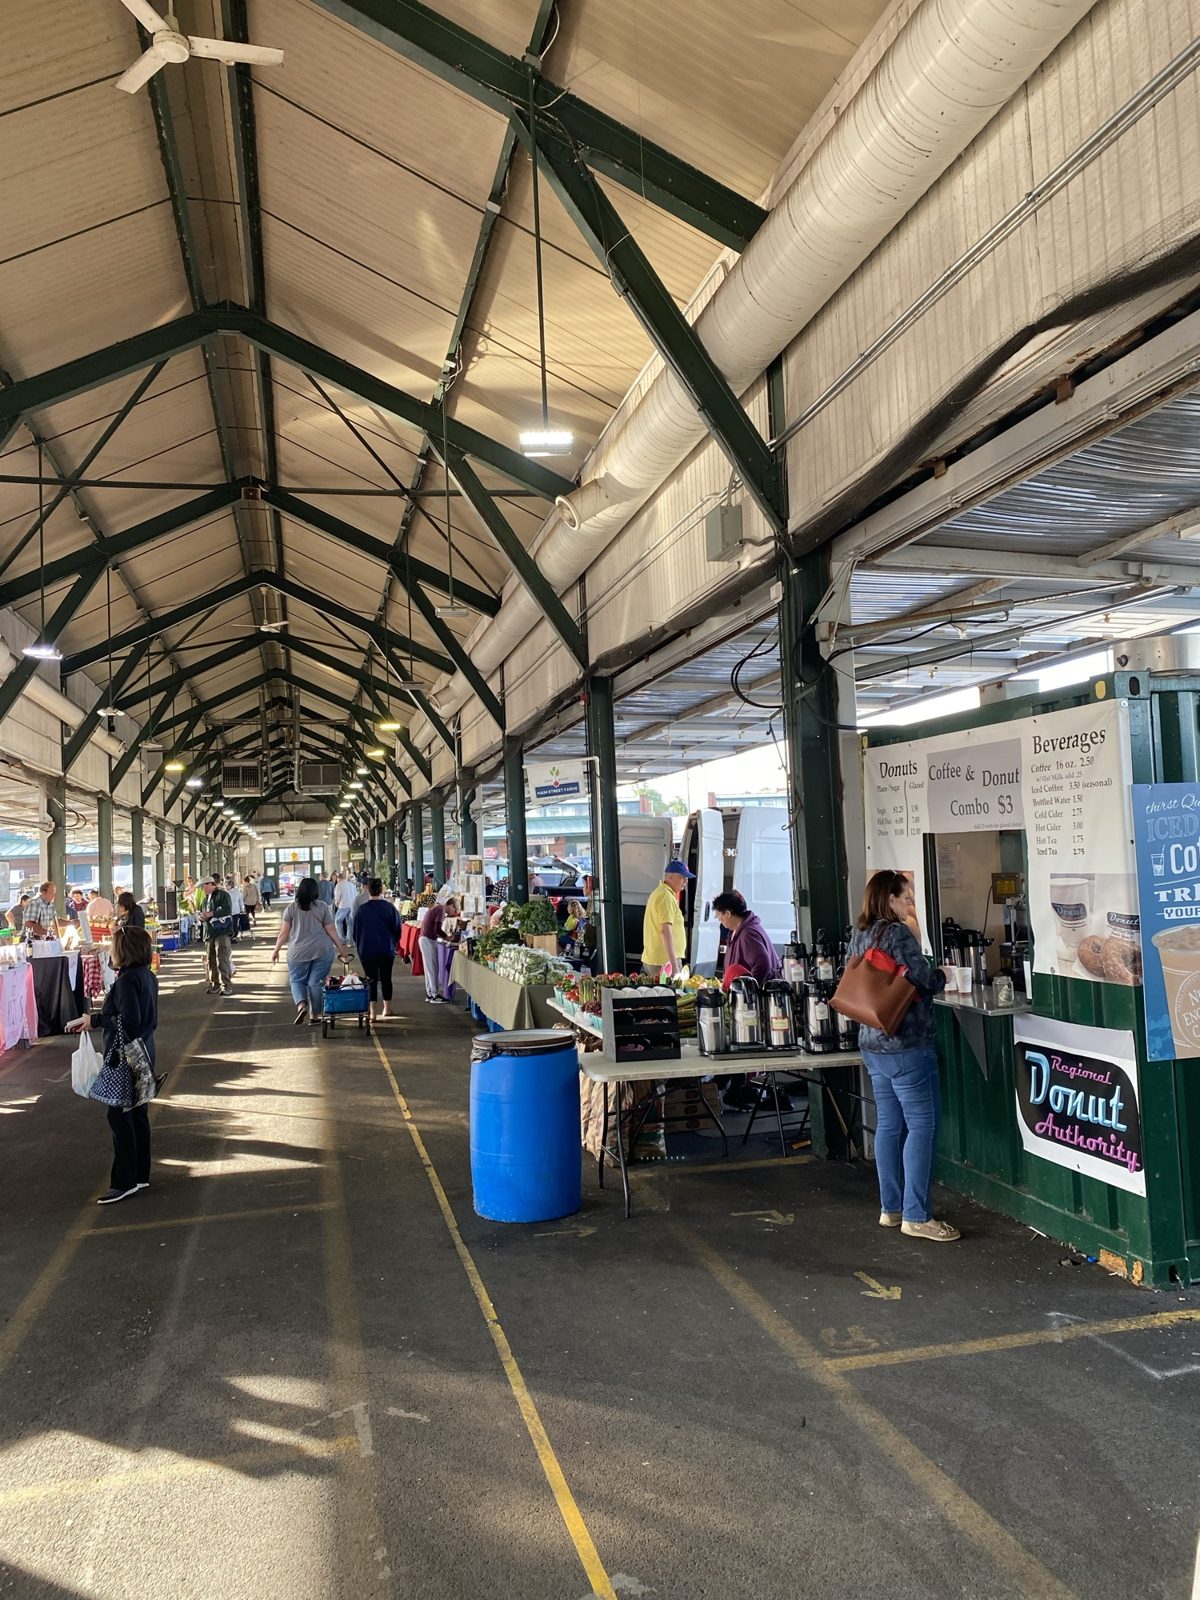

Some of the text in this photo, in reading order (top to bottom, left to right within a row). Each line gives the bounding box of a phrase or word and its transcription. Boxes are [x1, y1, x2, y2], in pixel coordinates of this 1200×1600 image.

[1032, 729, 1106, 754] Beverages
[879, 759, 918, 779] Donuts
[1030, 763, 1051, 773] Coffee
[1055, 760, 1064, 770] 16
[1080, 755, 1095, 767] 2.50
[928, 761, 1020, 787] Coffee & Donut
[1031, 785, 1043, 794] Iced
[1043, 783, 1065, 793] Coffee
[1081, 777, 1113, 789] (seasonal)
[950, 794, 1014, 816] Combo $3
[1053, 796, 1071, 804] Water
[1145, 798, 1180, 814] thirst
[1034, 810, 1047, 819] Cold
[1048, 810, 1063, 819] Cider
[1035, 823, 1046, 832] Hot
[1046, 822, 1061, 831] Cider
[1145, 813, 1199, 842] ICED
[1036, 836, 1046, 845] Hot
[1047, 836, 1057, 844] Tea
[1036, 847, 1085, 856] Iced Tea 2.75
[1170, 835, 1200, 875] Co
[1110, 912, 1139, 925] Donut
[1050, 1055, 1113, 1085] Regional
[1025, 1050, 1127, 1132] Donut
[1035, 1112, 1140, 1173] Authority
